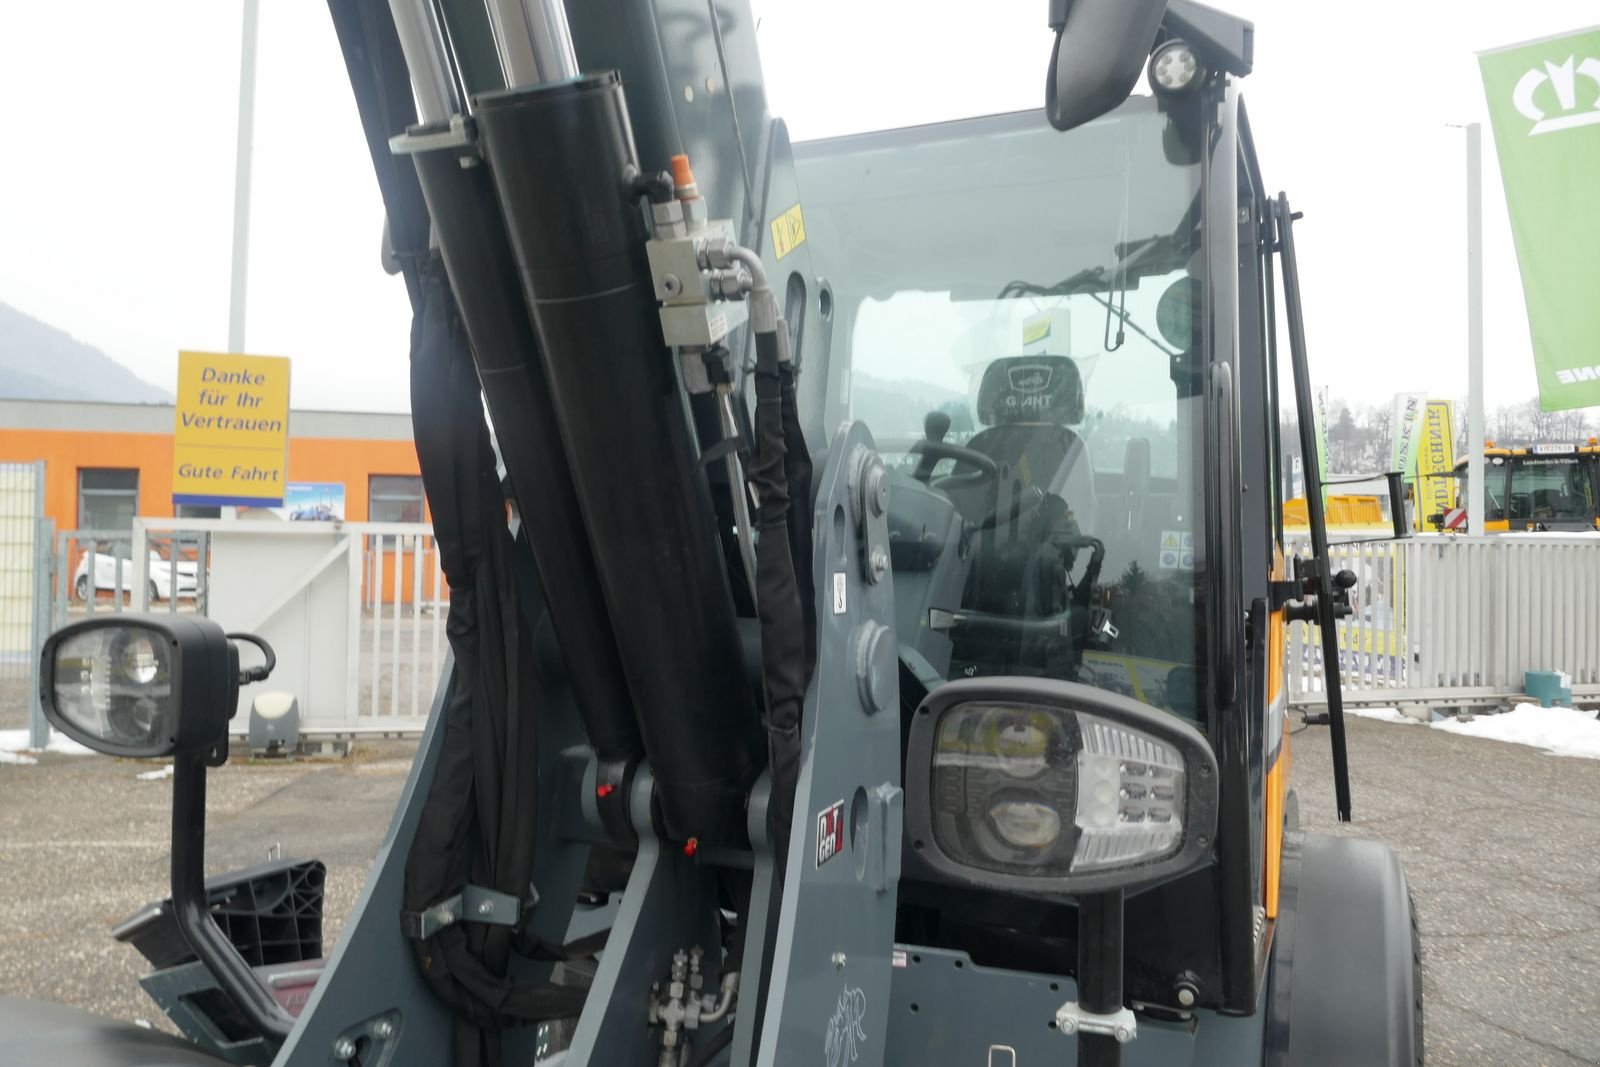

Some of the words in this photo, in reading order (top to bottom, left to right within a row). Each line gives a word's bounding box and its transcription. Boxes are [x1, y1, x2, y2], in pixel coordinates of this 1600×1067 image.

[202, 367, 266, 387] Danke
[200, 389, 228, 407] für
[237, 391, 264, 408] Ihr
[181, 411, 282, 432] Vertrauen
[178, 463, 223, 480] Gute
[231, 466, 279, 481] Fahrt
